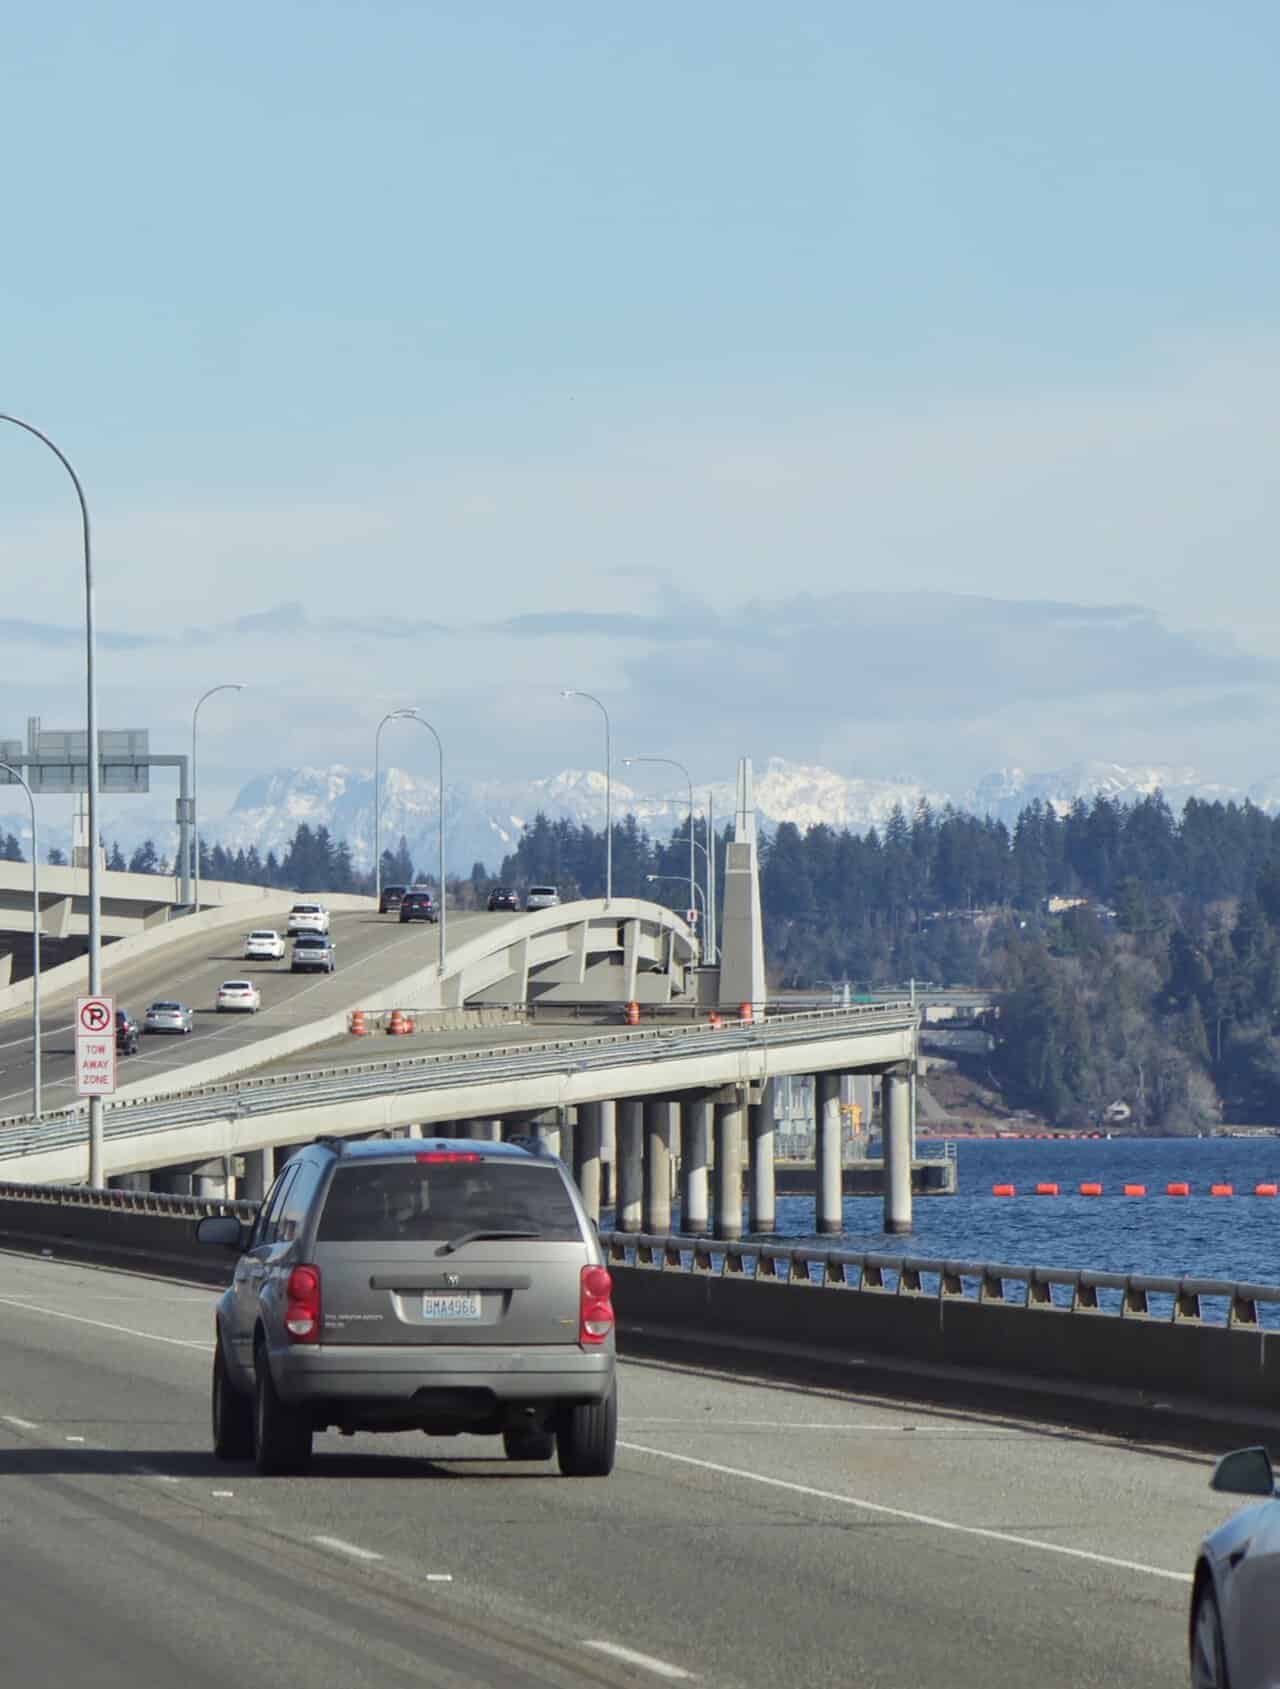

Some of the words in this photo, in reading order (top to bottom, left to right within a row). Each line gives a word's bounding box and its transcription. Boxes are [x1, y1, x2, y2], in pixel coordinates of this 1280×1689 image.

[86, 1044, 106, 1055] TOW
[82, 1060, 109, 1069] AWAY
[83, 1074, 109, 1085] ZONE
